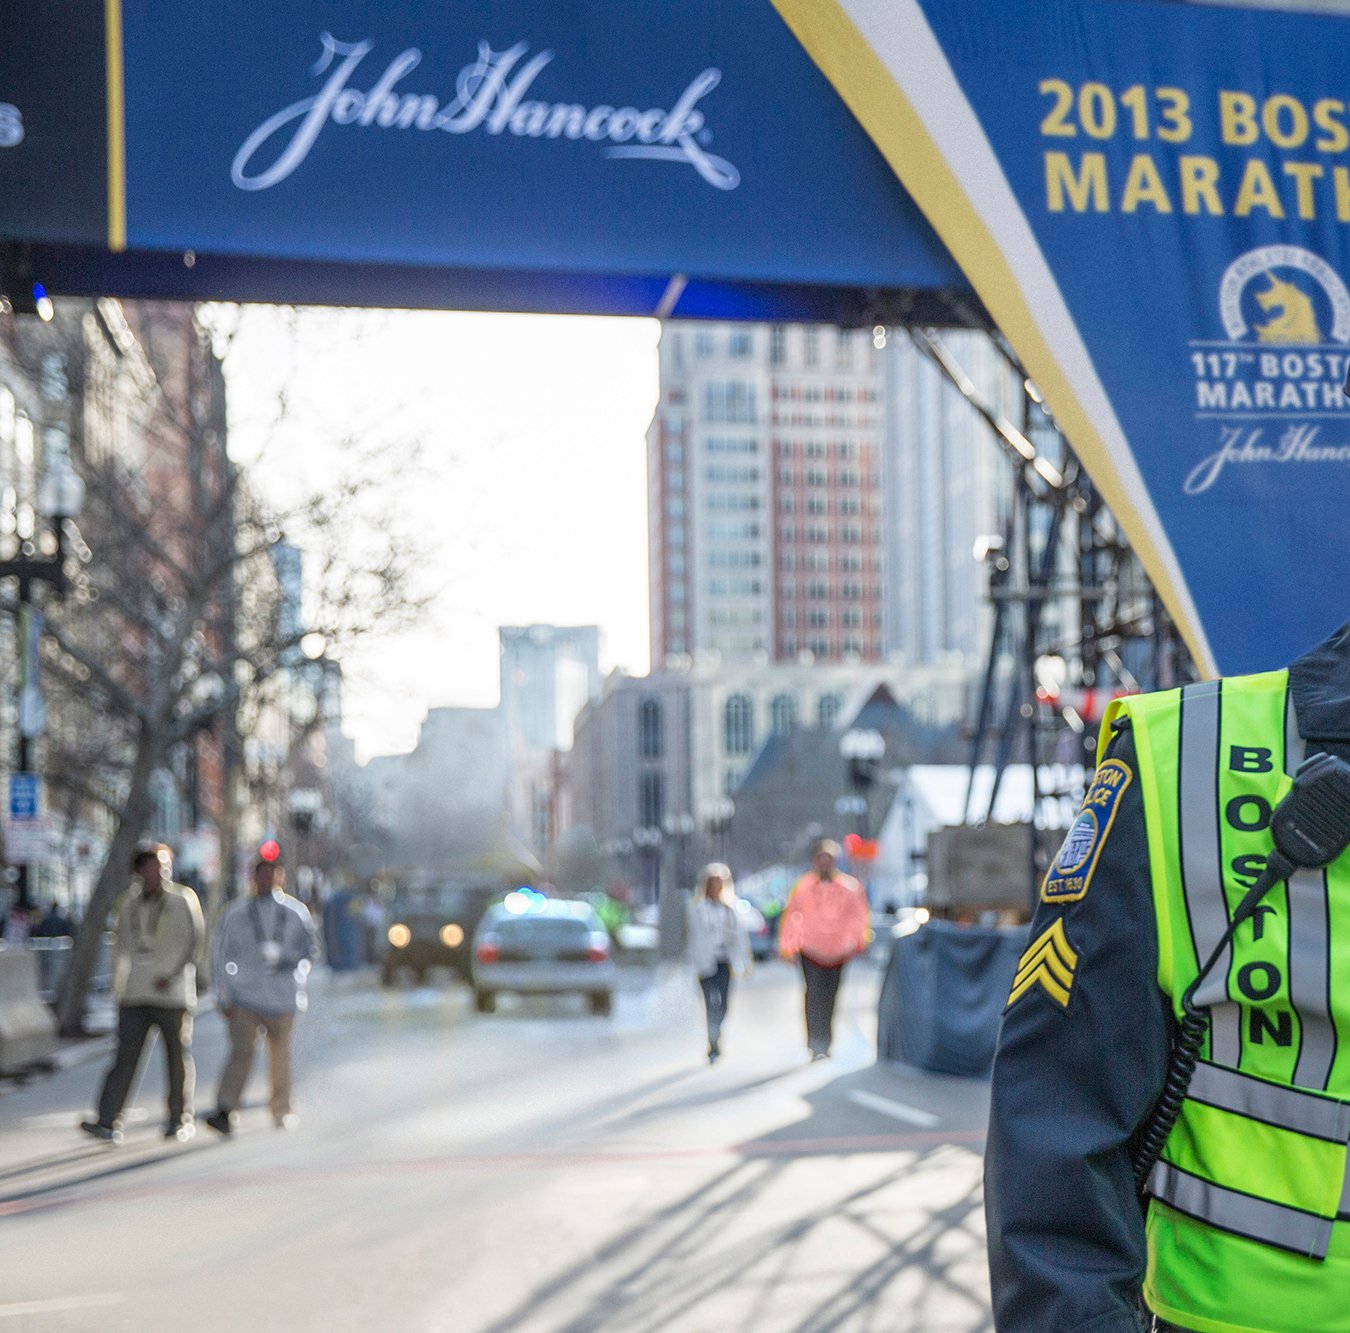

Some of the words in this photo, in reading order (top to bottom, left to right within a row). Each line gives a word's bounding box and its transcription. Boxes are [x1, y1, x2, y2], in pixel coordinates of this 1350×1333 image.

[231, 30, 440, 191] John
[430, 38, 741, 191] Hancock
[1038, 78, 1193, 144] 2013
[1183, 424, 1273, 495] John
[1224, 744, 1294, 1048] BOSTON
